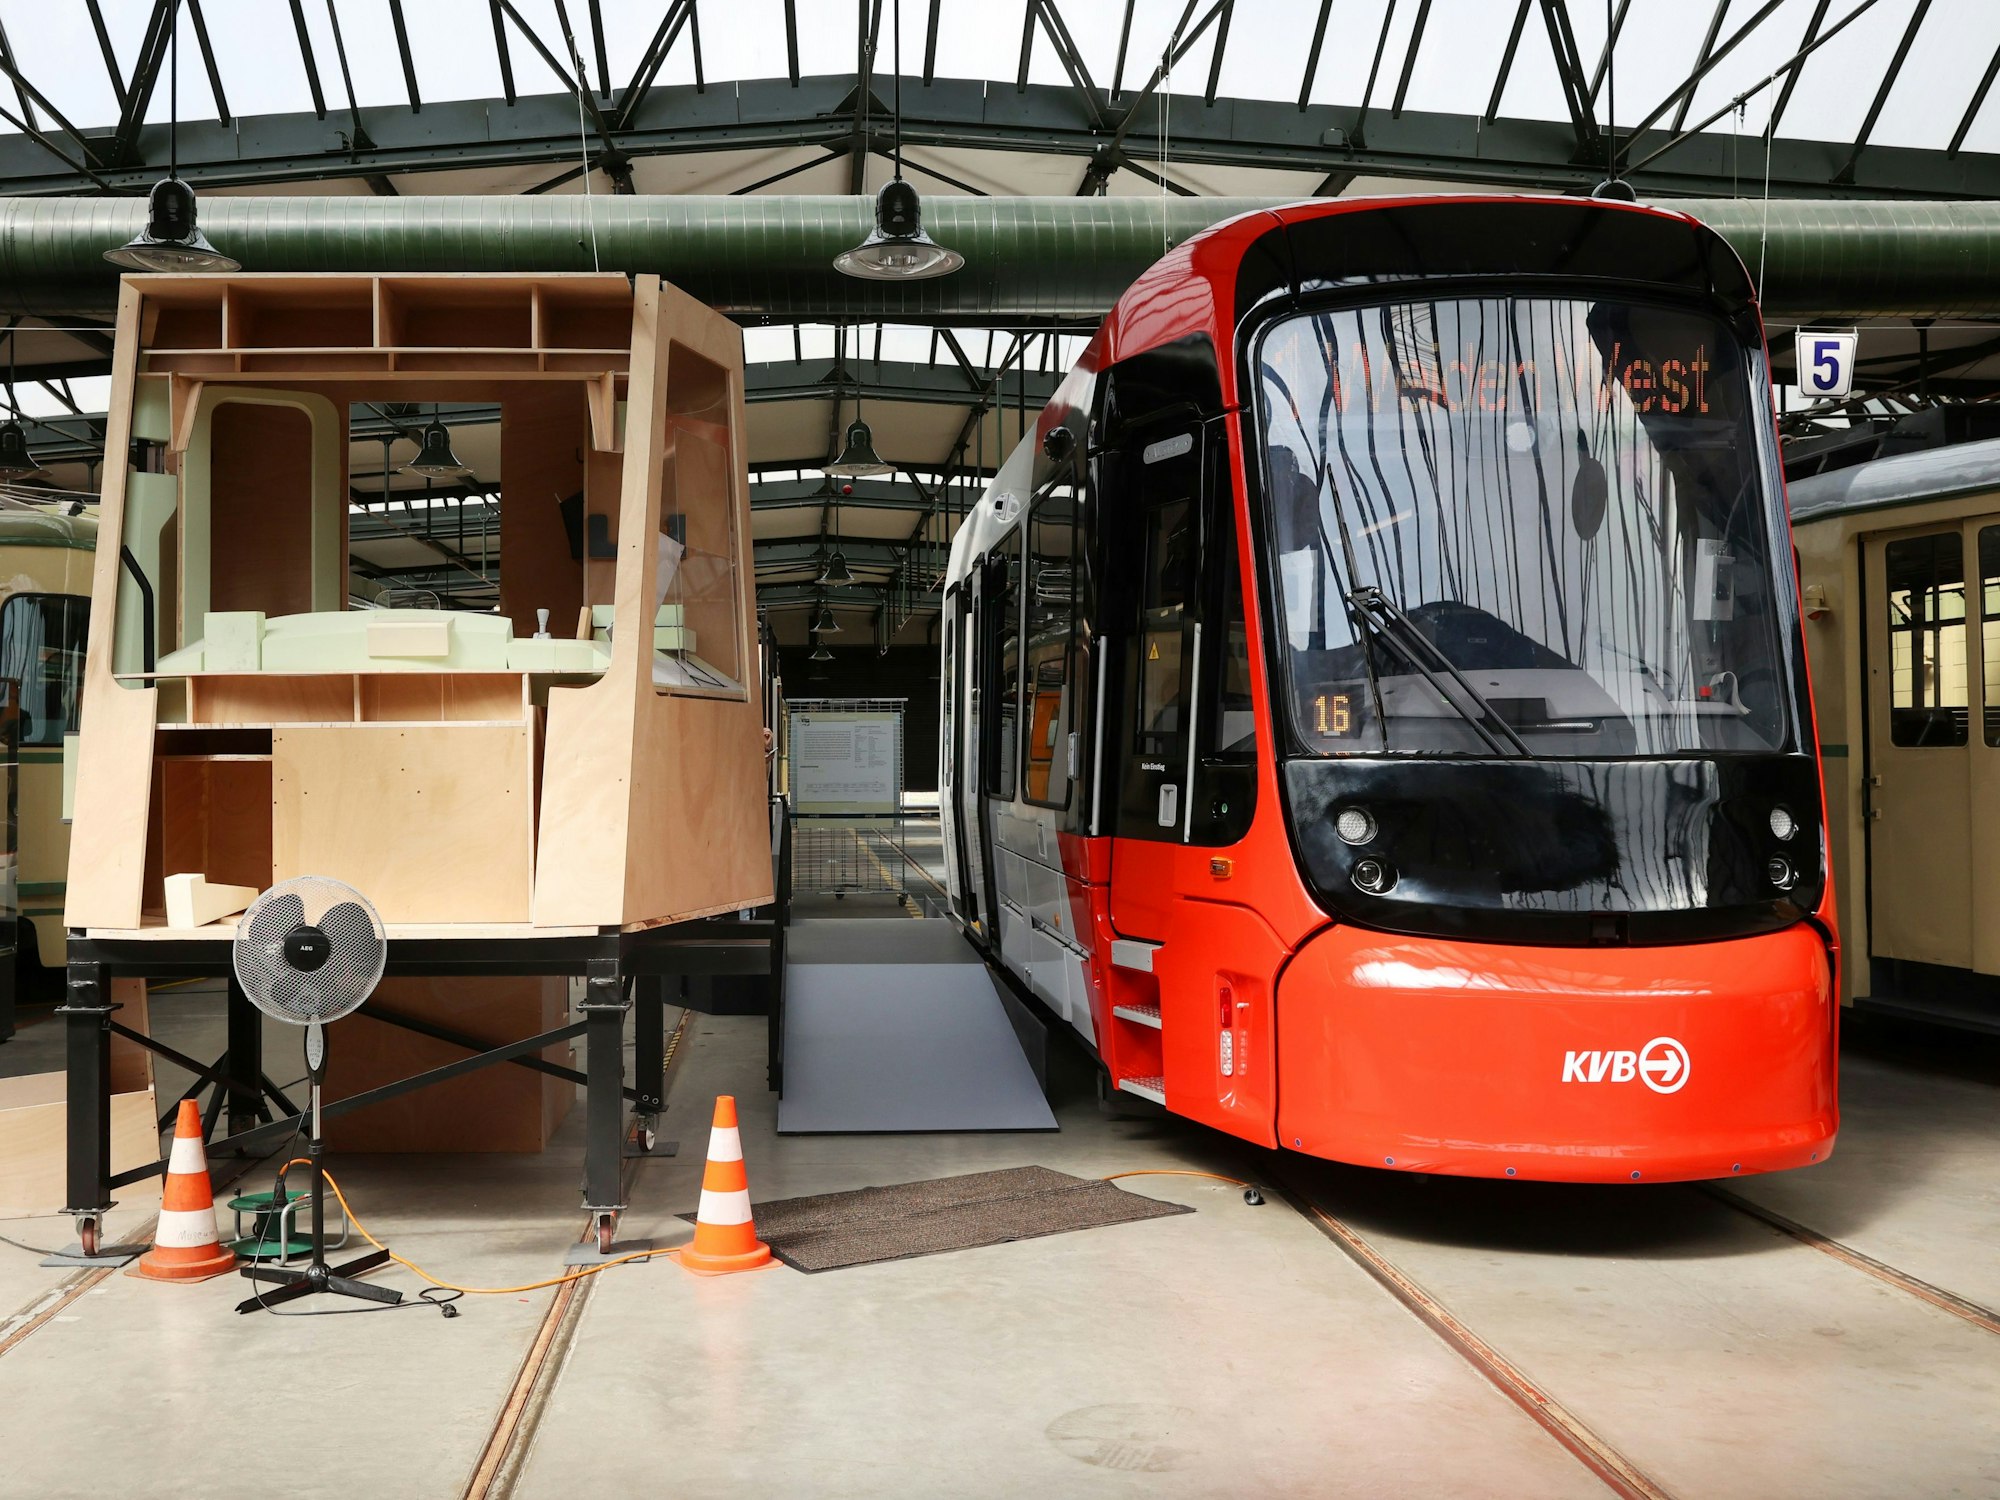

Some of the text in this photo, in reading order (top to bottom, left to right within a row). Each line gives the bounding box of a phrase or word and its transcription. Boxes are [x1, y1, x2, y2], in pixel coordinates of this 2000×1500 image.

[1554, 341, 1711, 414] West
[1813, 341, 1840, 391] 5
[1315, 695, 1349, 732] 16
[1561, 1050, 1638, 1083] KVB
